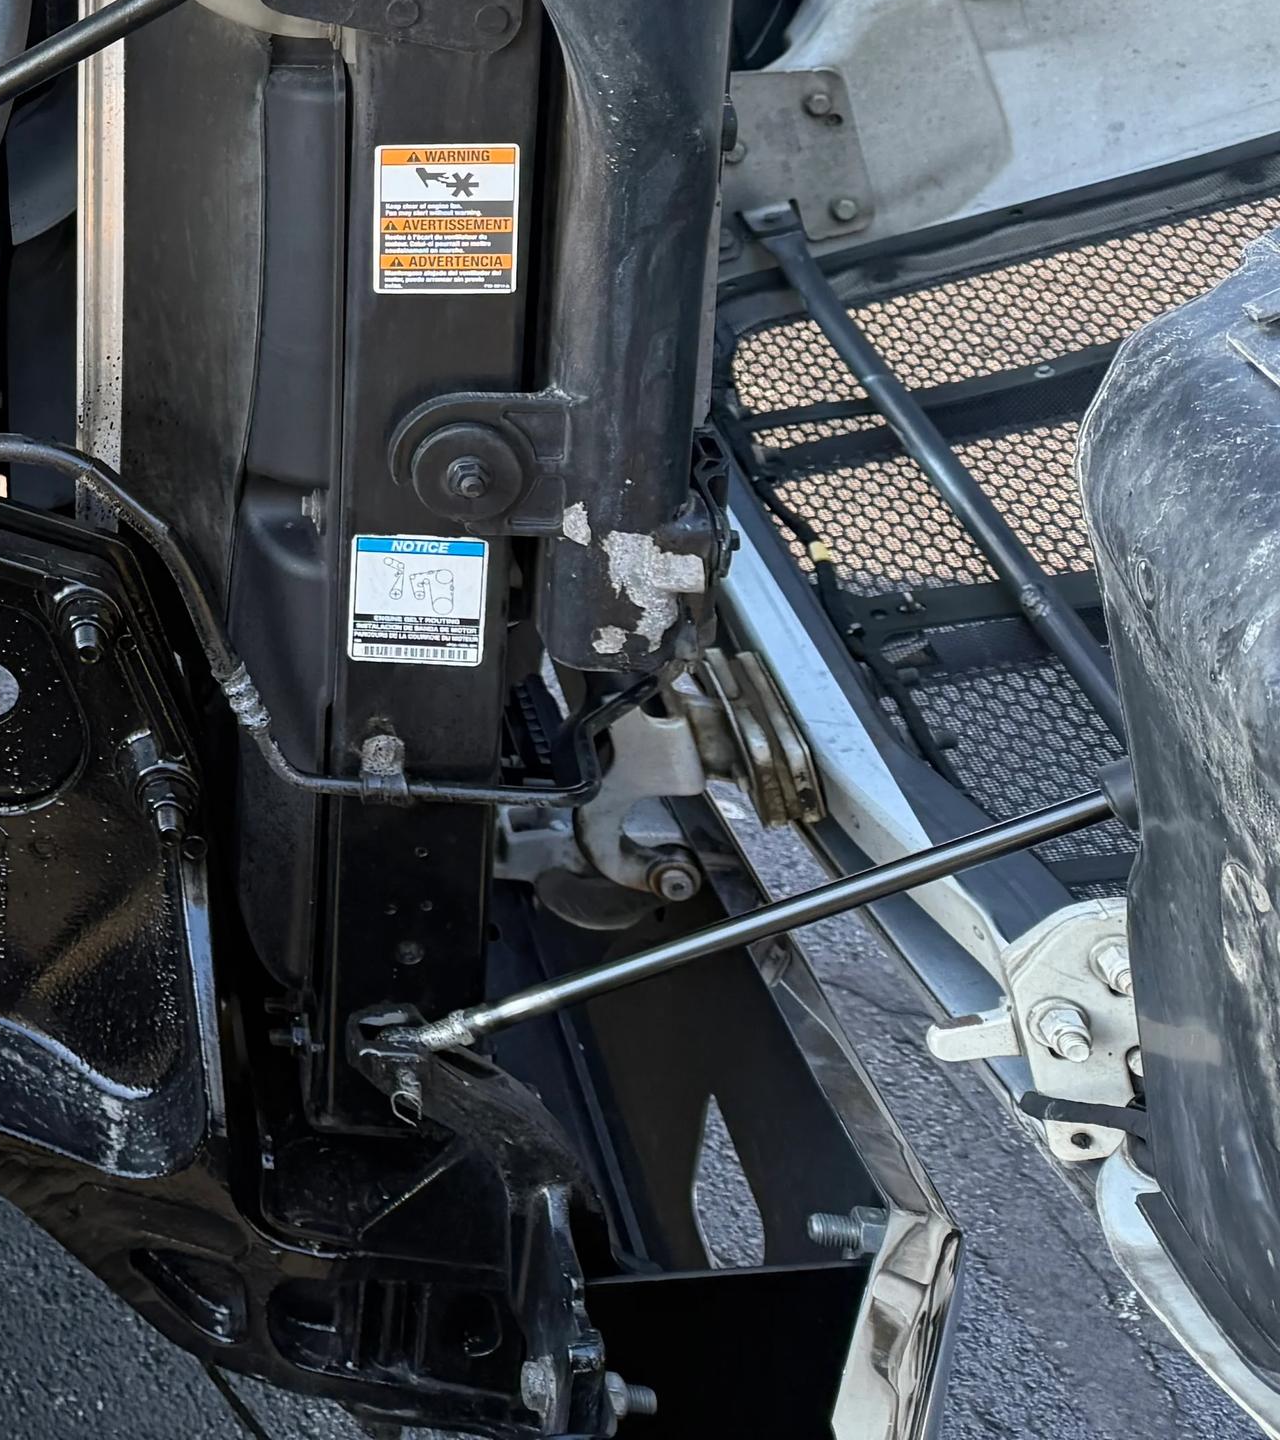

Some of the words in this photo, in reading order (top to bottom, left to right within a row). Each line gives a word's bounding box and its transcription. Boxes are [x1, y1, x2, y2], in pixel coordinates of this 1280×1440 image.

[425, 150, 490, 161] WARNING
[402, 219, 510, 231] AVERTISSEMENT
[408, 256, 503, 267] ADVERTENCIA
[391, 540, 450, 553] NOTICE
